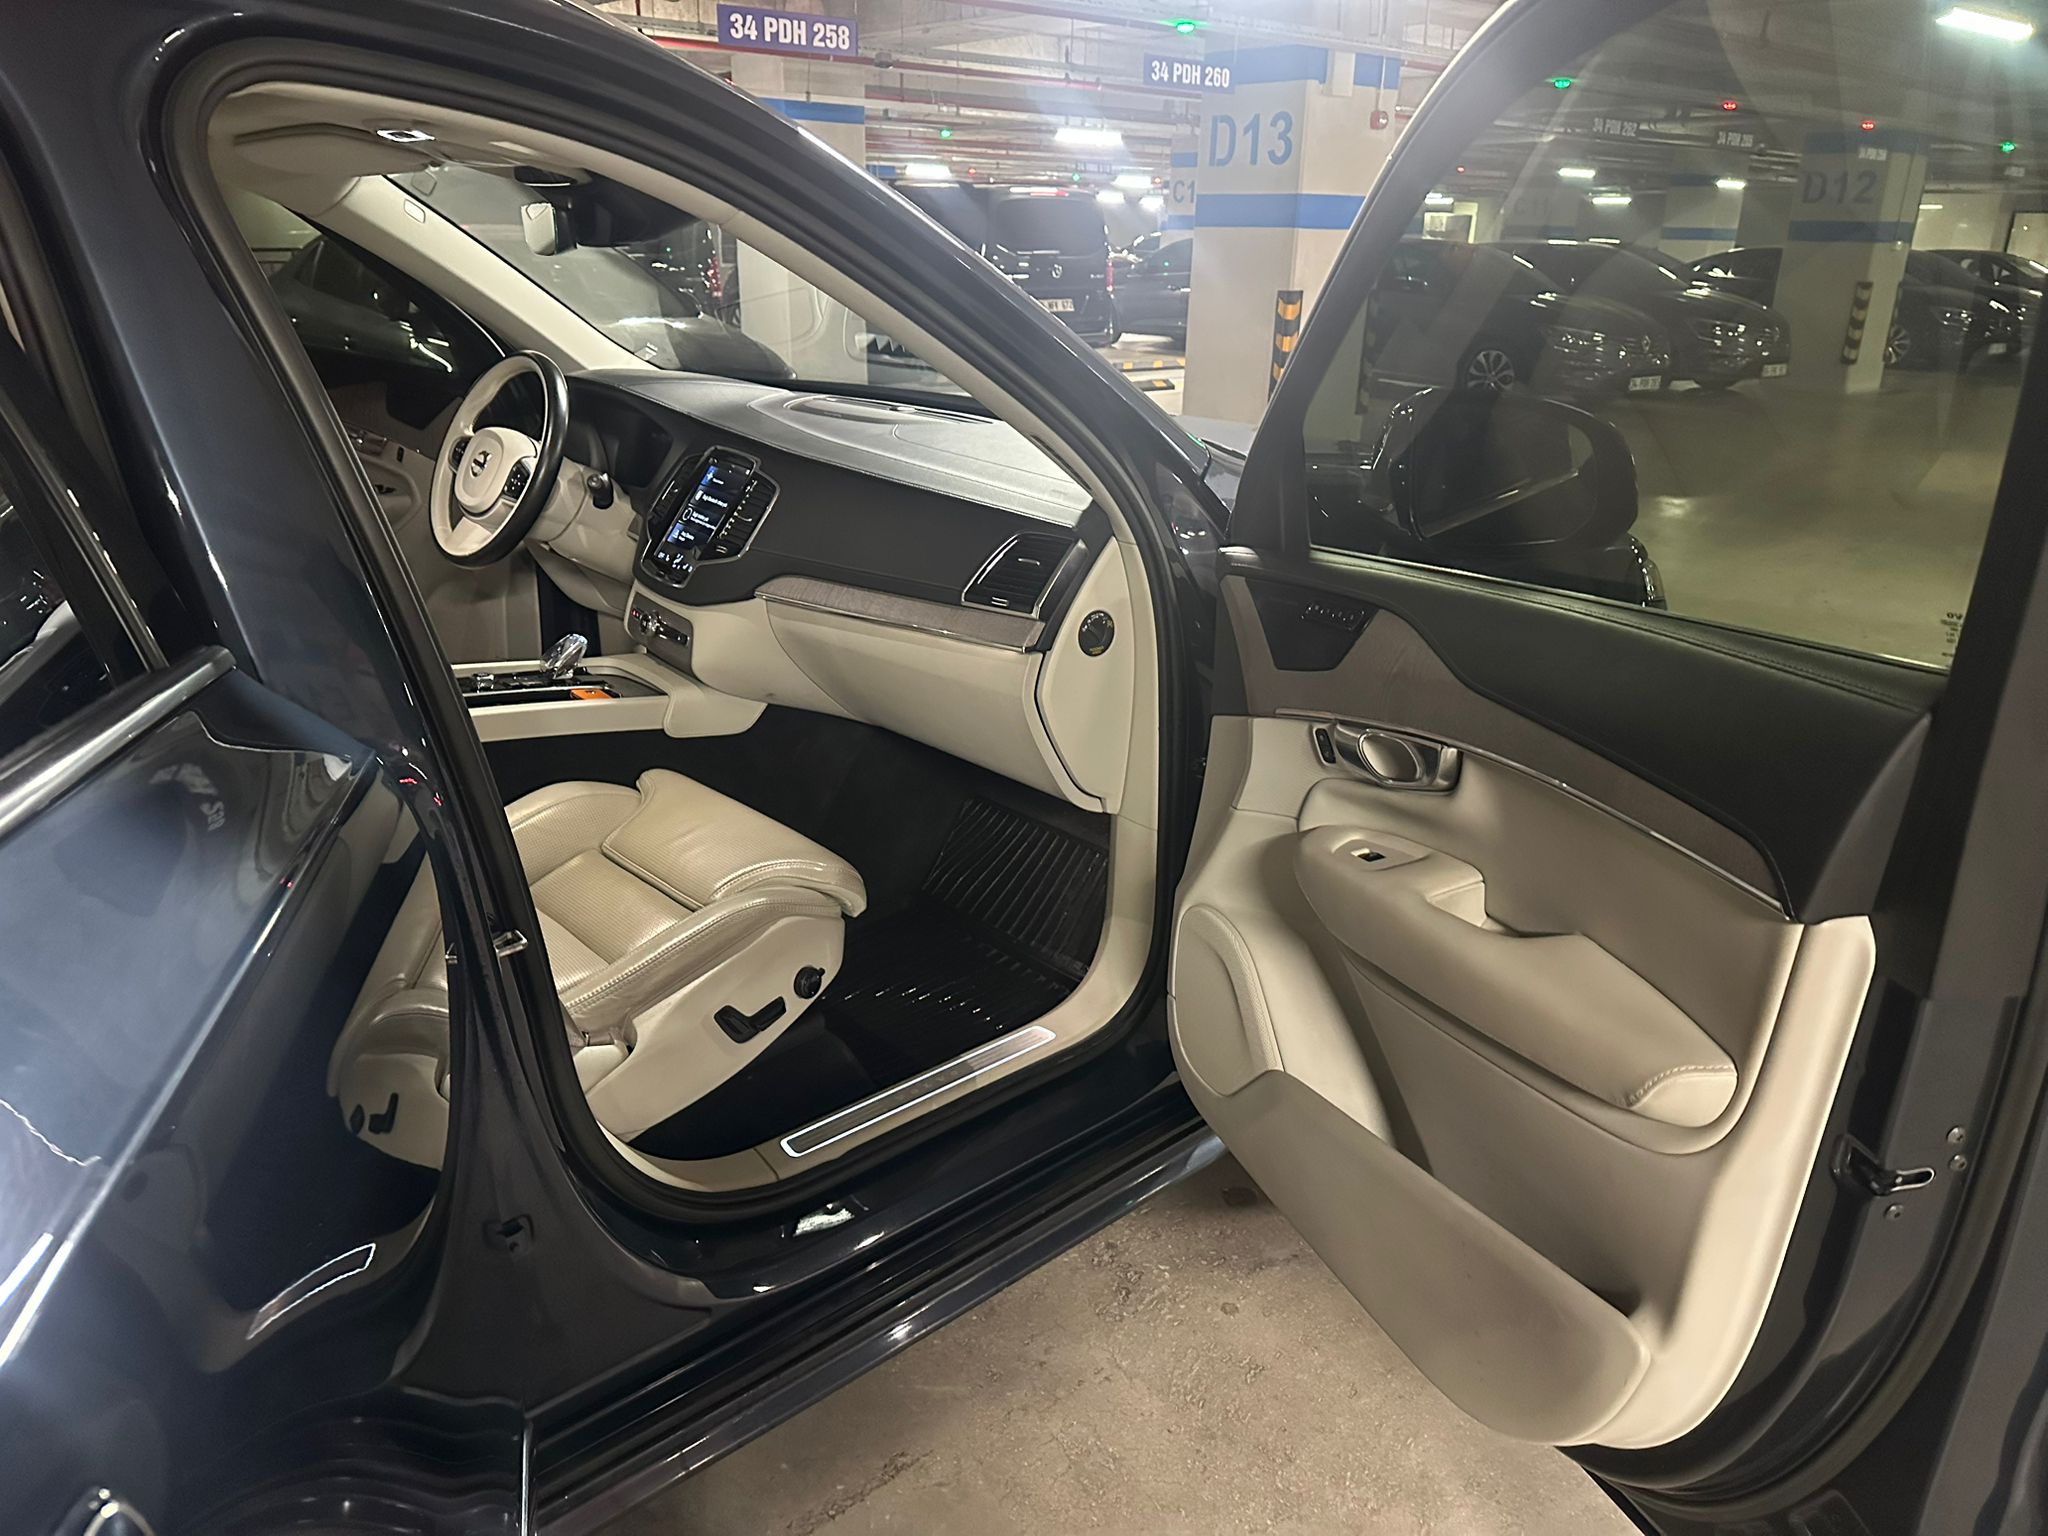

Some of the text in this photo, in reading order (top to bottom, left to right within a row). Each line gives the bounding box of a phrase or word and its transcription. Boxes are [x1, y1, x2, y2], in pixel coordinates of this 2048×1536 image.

[729, 12, 850, 50] 34 PDH 258
[1151, 60, 1230, 88] 34 PDH 260
[1208, 110, 1293, 167] D13
[1801, 169, 1877, 204] D12
